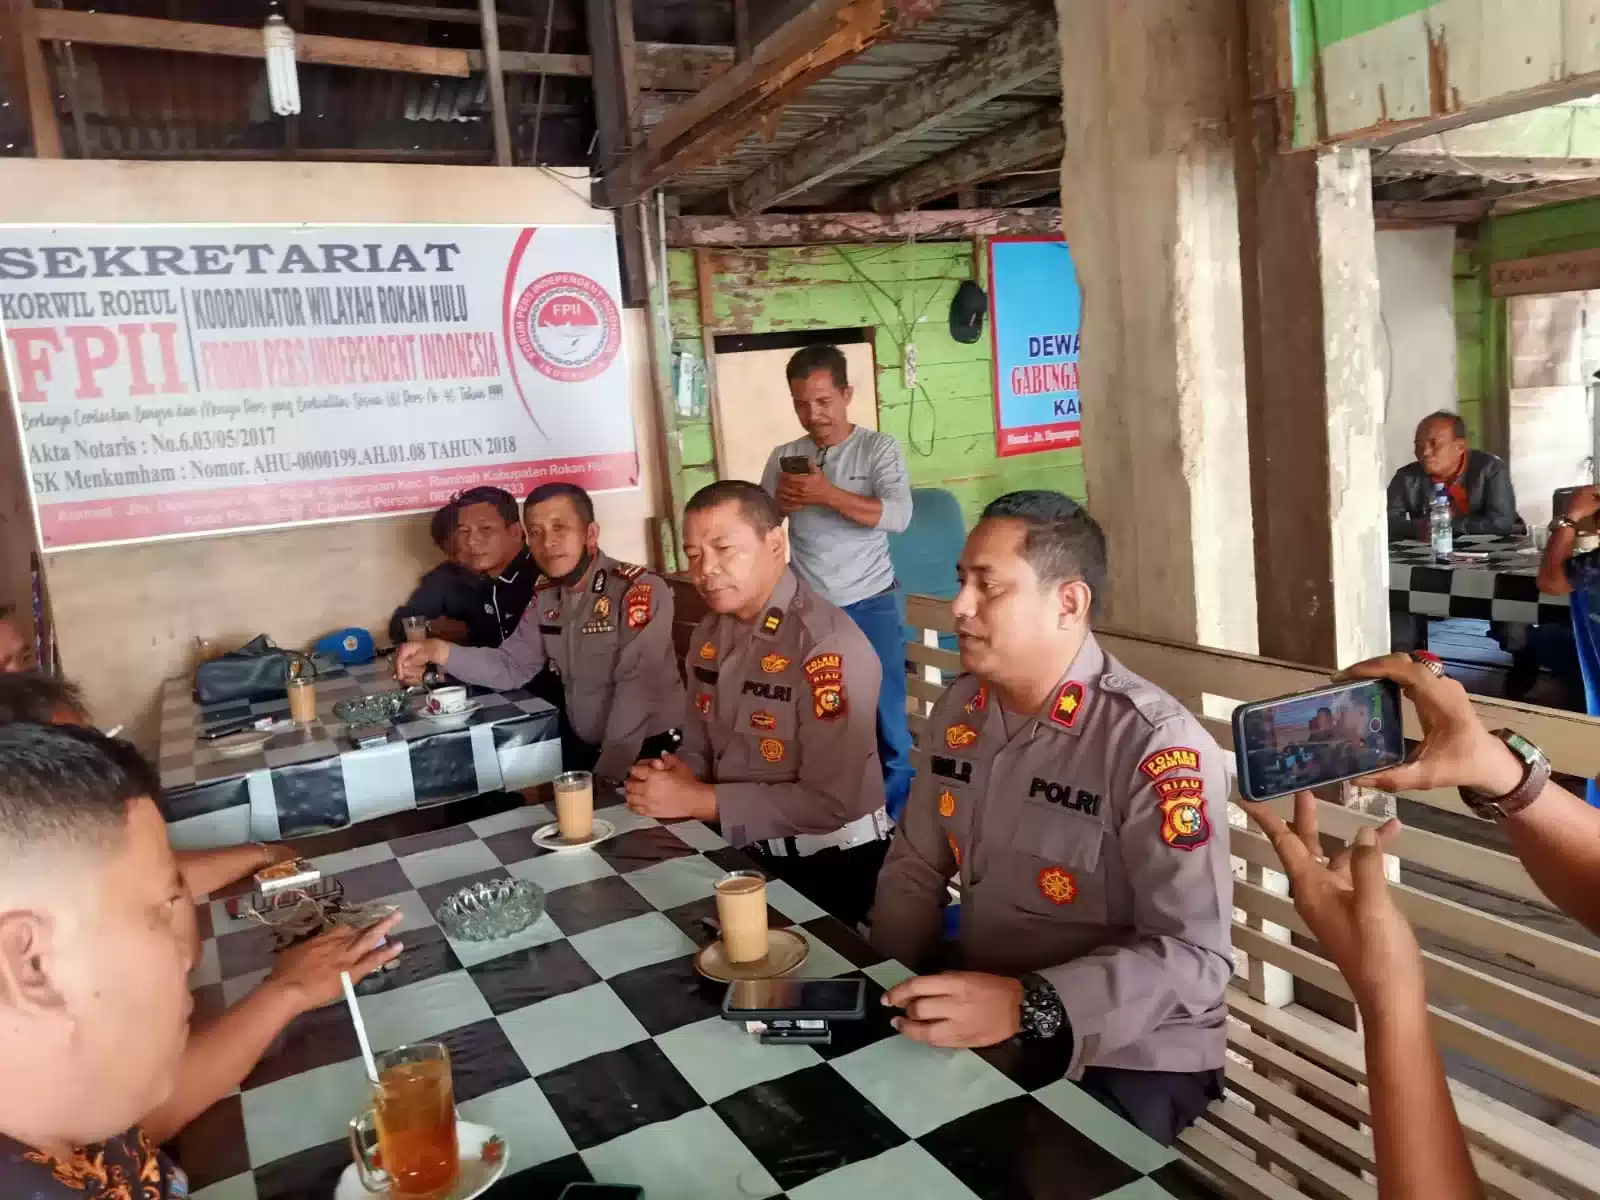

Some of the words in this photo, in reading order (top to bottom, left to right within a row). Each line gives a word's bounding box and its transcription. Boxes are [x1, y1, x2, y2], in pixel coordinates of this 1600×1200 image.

[0, 243, 462, 279] SEKRETARIAT
[0, 290, 94, 320] KORWIL
[98, 288, 177, 317] ROHUL
[192, 287, 306, 330] KOORDINATOR
[306, 285, 377, 326] WILAYAH
[377, 285, 429, 324] ROKAN
[430, 284, 468, 322] HULU
[553, 303, 581, 316] FPII
[5, 322, 189, 402] FPII
[309, 334, 417, 385] INDEPENDENT
[420, 331, 500, 380] INDONESIA
[1053, 398, 1082, 417] KA
[29, 444, 71, 464] Akta
[75, 436, 137, 460] Notaris
[34, 472, 59, 494] SK
[65, 464, 176, 491] Menkumham
[428, 438, 483, 460] TAHUN
[487, 435, 517, 455] 2018
[741, 680, 792, 703] POLRI
[1028, 776, 1101, 817] POLRI
[1161, 779, 1200, 792] RIAU
